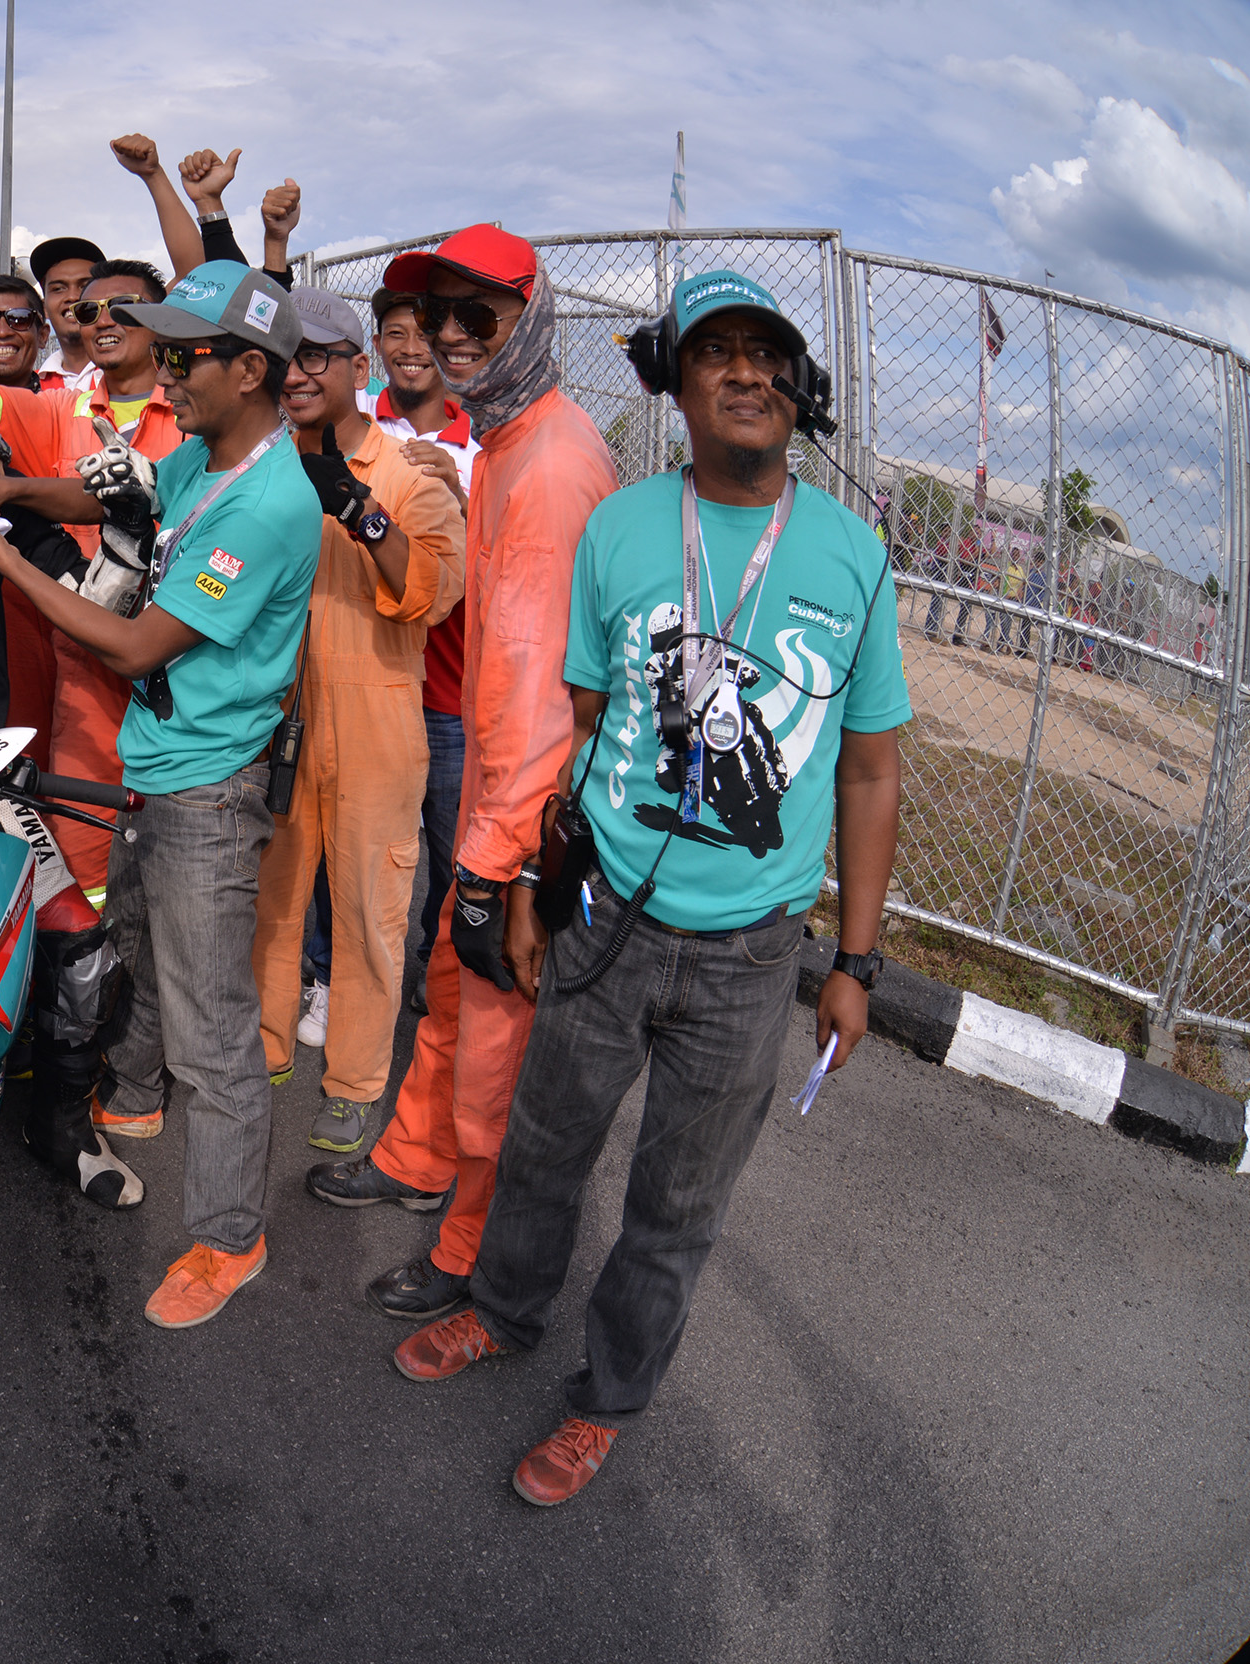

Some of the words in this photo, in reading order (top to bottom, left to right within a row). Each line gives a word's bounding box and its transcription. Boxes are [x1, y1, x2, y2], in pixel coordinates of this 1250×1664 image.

[683, 277, 745, 299] PETRONAS
[686, 283, 761, 306] CubPrix
[197, 577, 225, 597] AAM
[788, 595, 834, 617] PETRONAS
[788, 603, 842, 631] CubPrix
[10, 800, 56, 866] YAMA
[11, 877, 33, 929] YAMAHA
